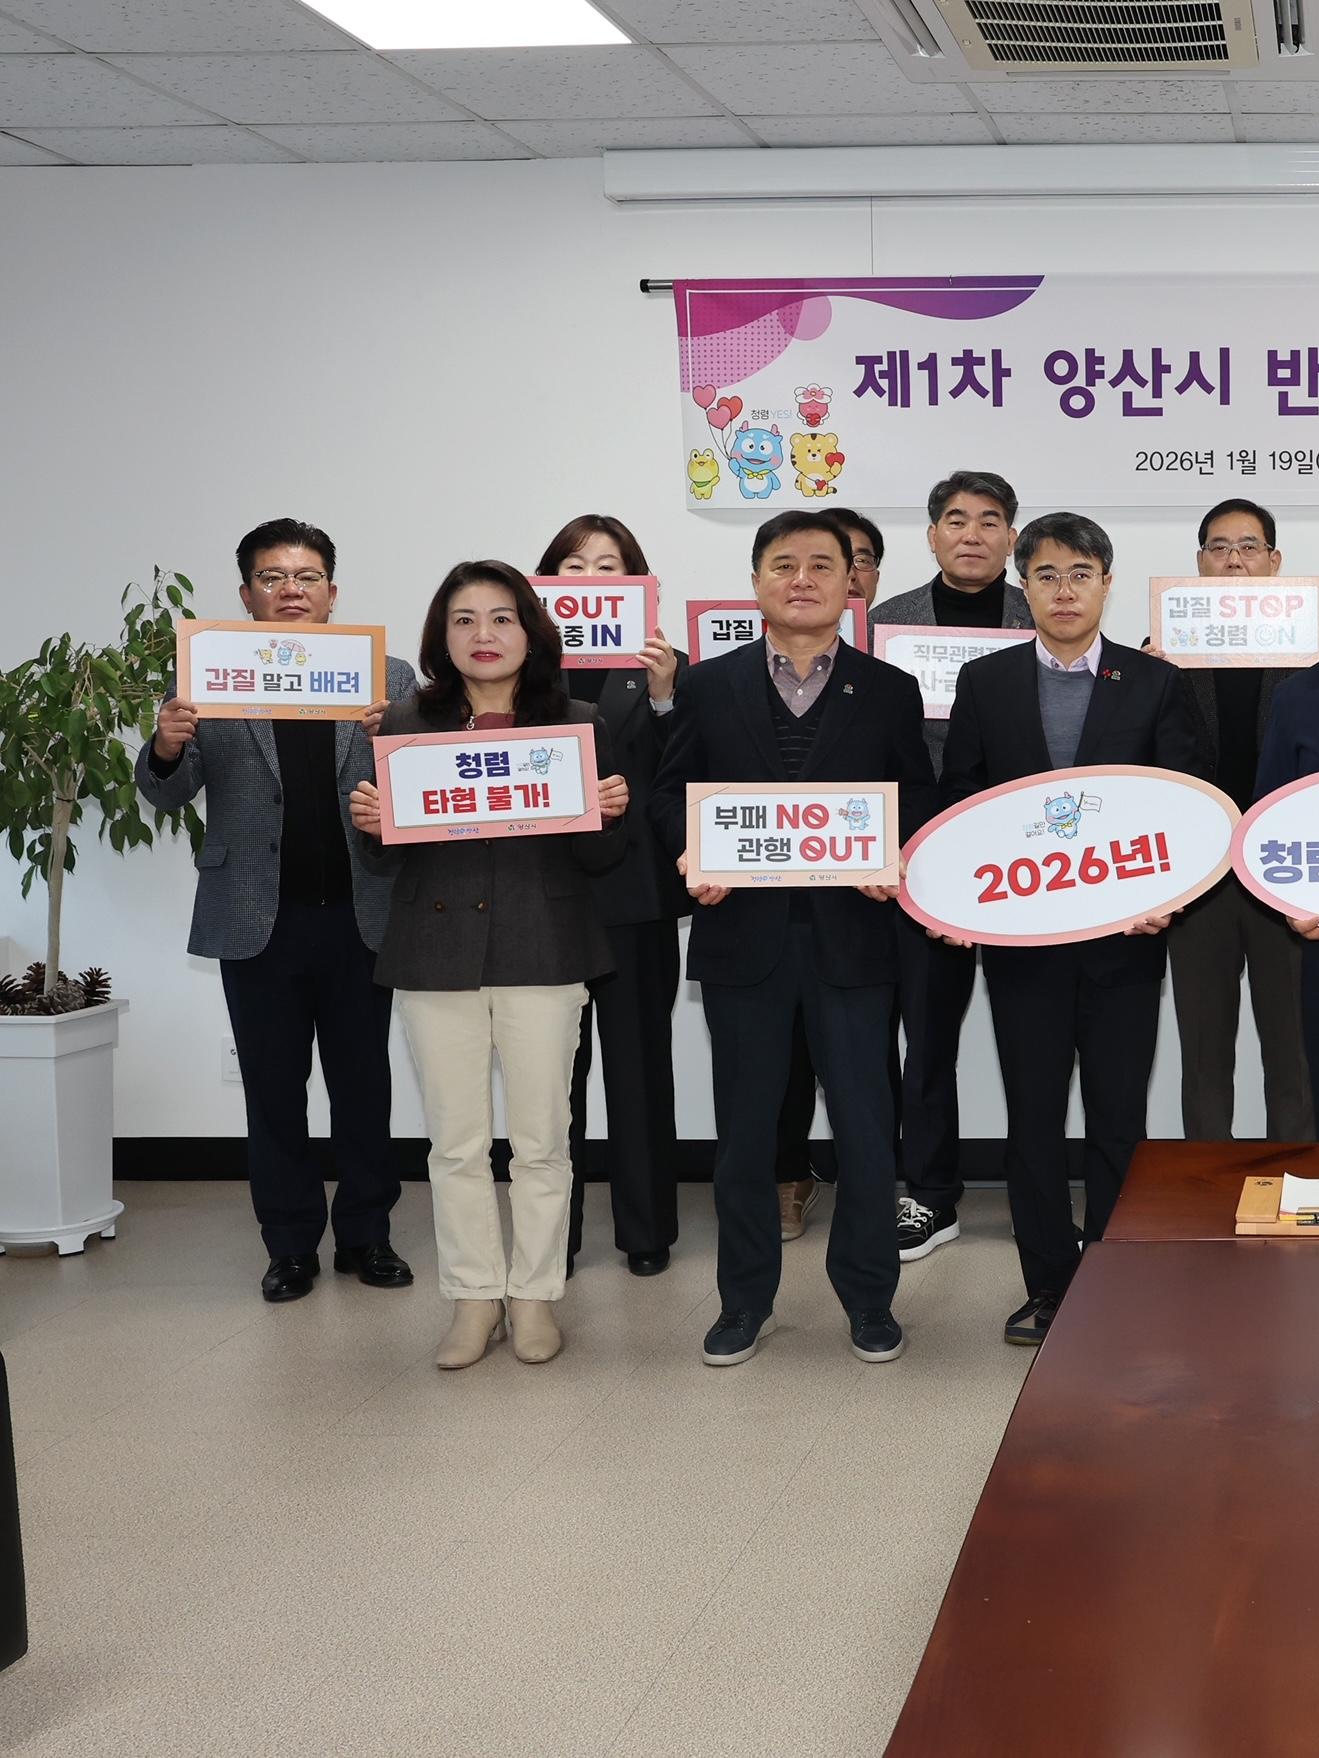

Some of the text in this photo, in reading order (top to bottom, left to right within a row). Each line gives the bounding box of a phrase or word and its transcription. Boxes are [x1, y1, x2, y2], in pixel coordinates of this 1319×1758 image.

[852, 348, 1012, 408] 제1차
[1043, 346, 1231, 419] 양산시
[1135, 449, 1214, 475] 2026년
[1226, 449, 1257, 475] 1월
[554, 595, 625, 619] OUT
[1168, 595, 1304, 619] 갑질 STOP
[556, 624, 622, 647] 중 IN
[711, 619, 754, 641] 갑질
[1205, 624, 1248, 647] 청렴
[205, 668, 360, 694] 갑질 말고 배려
[456, 751, 511, 780] 청렴
[422, 783, 551, 815] 타협 불가!
[715, 803, 830, 830] 부패 NO
[737, 835, 877, 862] 관행 OUT
[974, 831, 1172, 904] 2026년!
